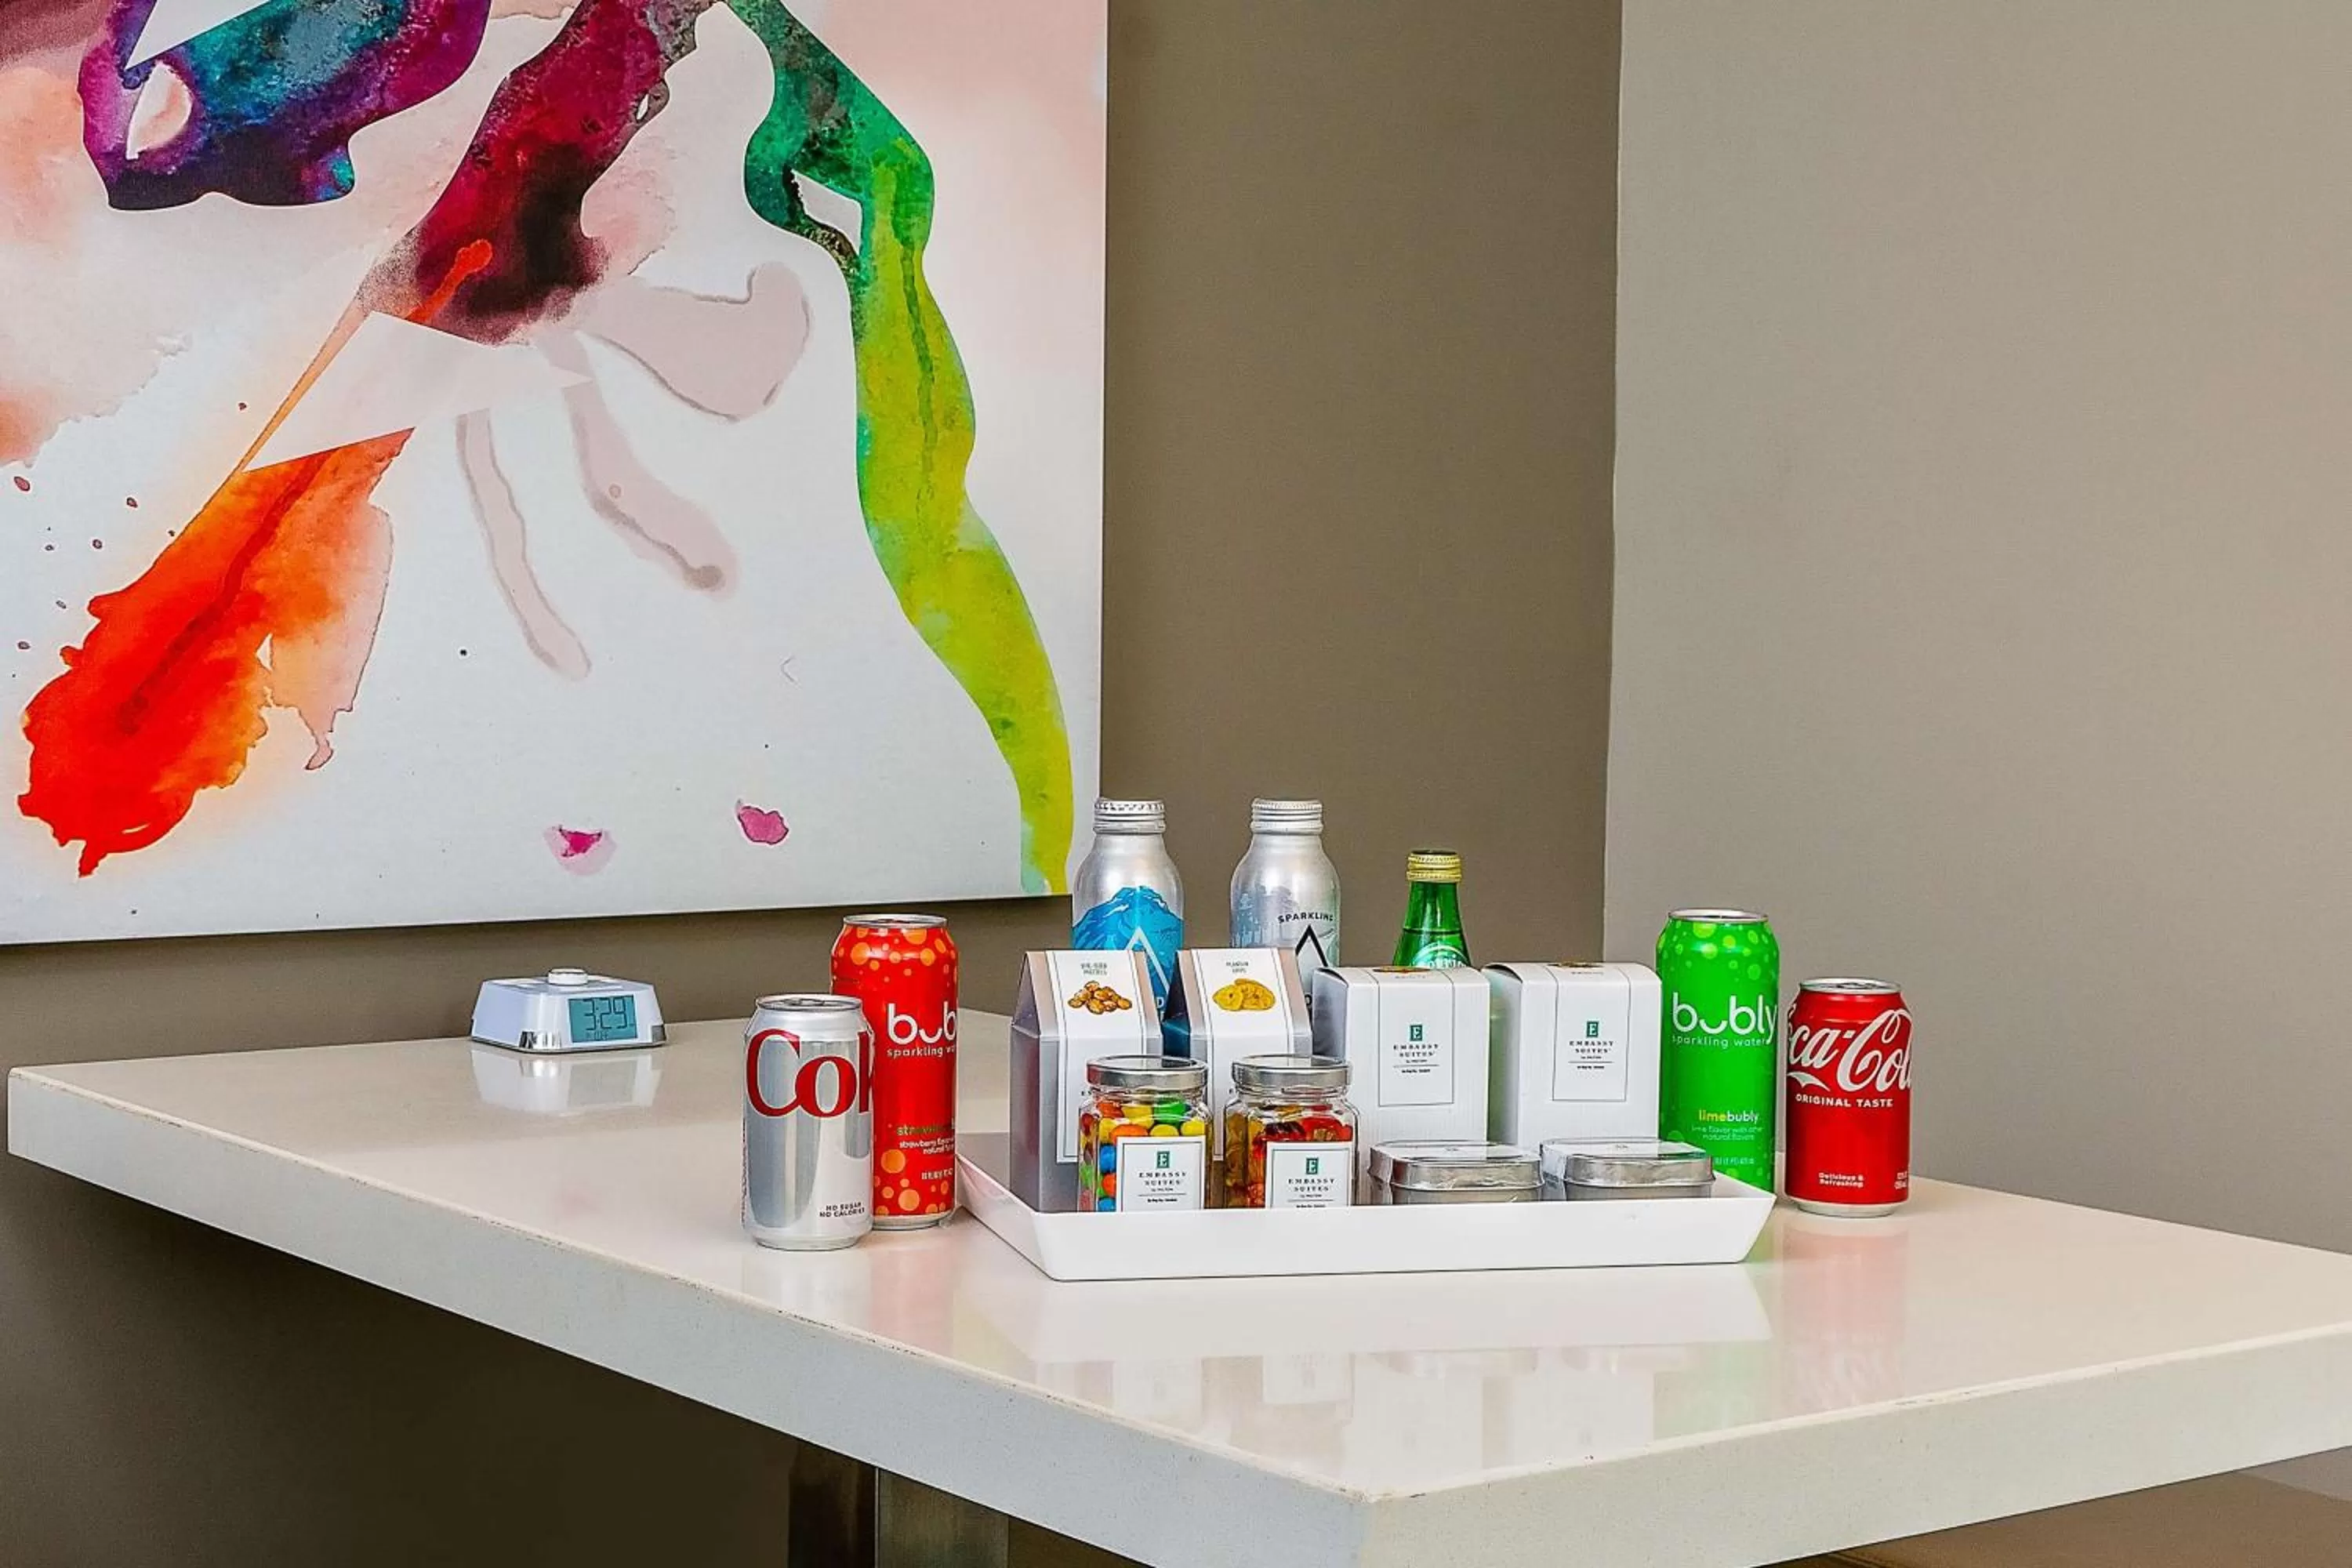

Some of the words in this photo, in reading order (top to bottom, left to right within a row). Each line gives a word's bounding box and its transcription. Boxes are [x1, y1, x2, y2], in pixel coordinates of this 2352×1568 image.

[583, 996, 627, 1030] 3:29
[1672, 992, 1777, 1045] bubly
[1671, 1035, 1729, 1050] sparkling
[887, 1046, 943, 1058] sparkling
[1795, 1094, 1852, 1108] ORIGINAL
[1856, 1098, 1894, 1108] TASTE
